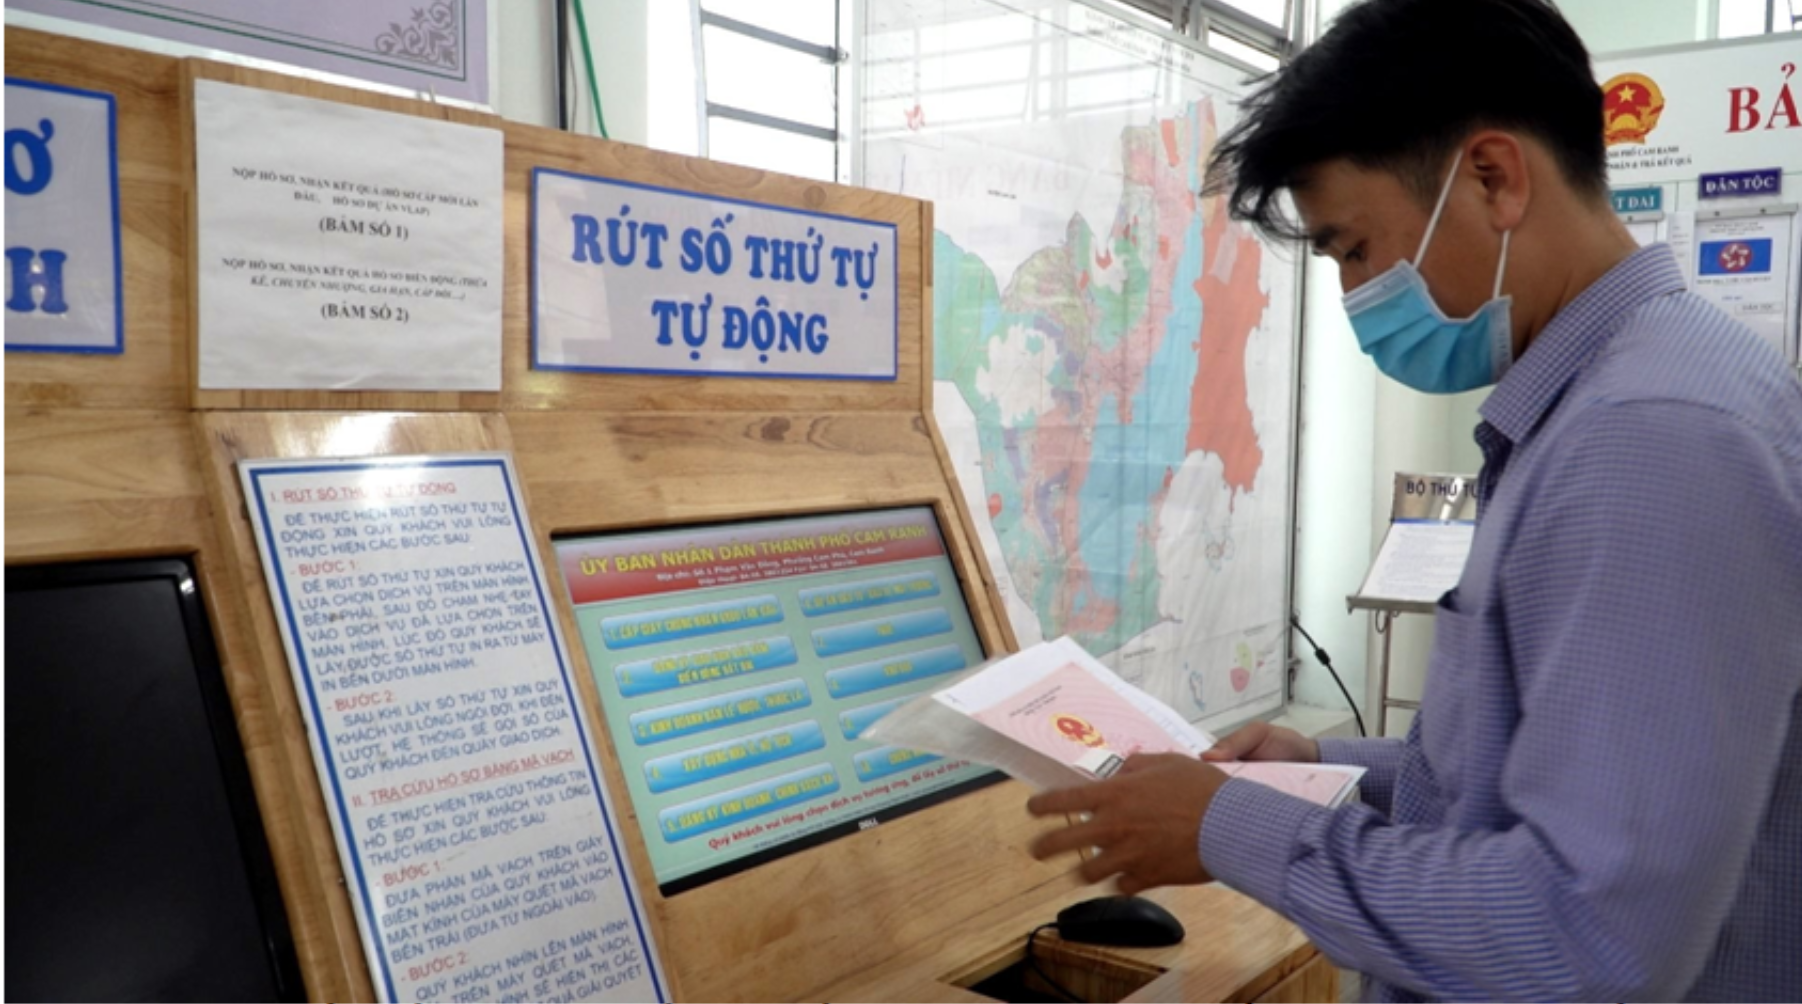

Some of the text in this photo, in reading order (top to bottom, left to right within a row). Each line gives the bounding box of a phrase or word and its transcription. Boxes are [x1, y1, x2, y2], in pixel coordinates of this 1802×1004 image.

[369, 219, 392, 238] SỐ
[571, 204, 879, 301] RÚT SỐ THỨ TỰ
[370, 302, 392, 321] SỐ
[651, 292, 830, 364] TỰ ĐỘNG
[579, 556, 611, 575] ỦY
[614, 554, 657, 571] BAN
[659, 544, 715, 565] NHÂN
[717, 539, 756, 559] DÂN
[853, 530, 886, 543] CAM
[889, 526, 927, 539] RANH
